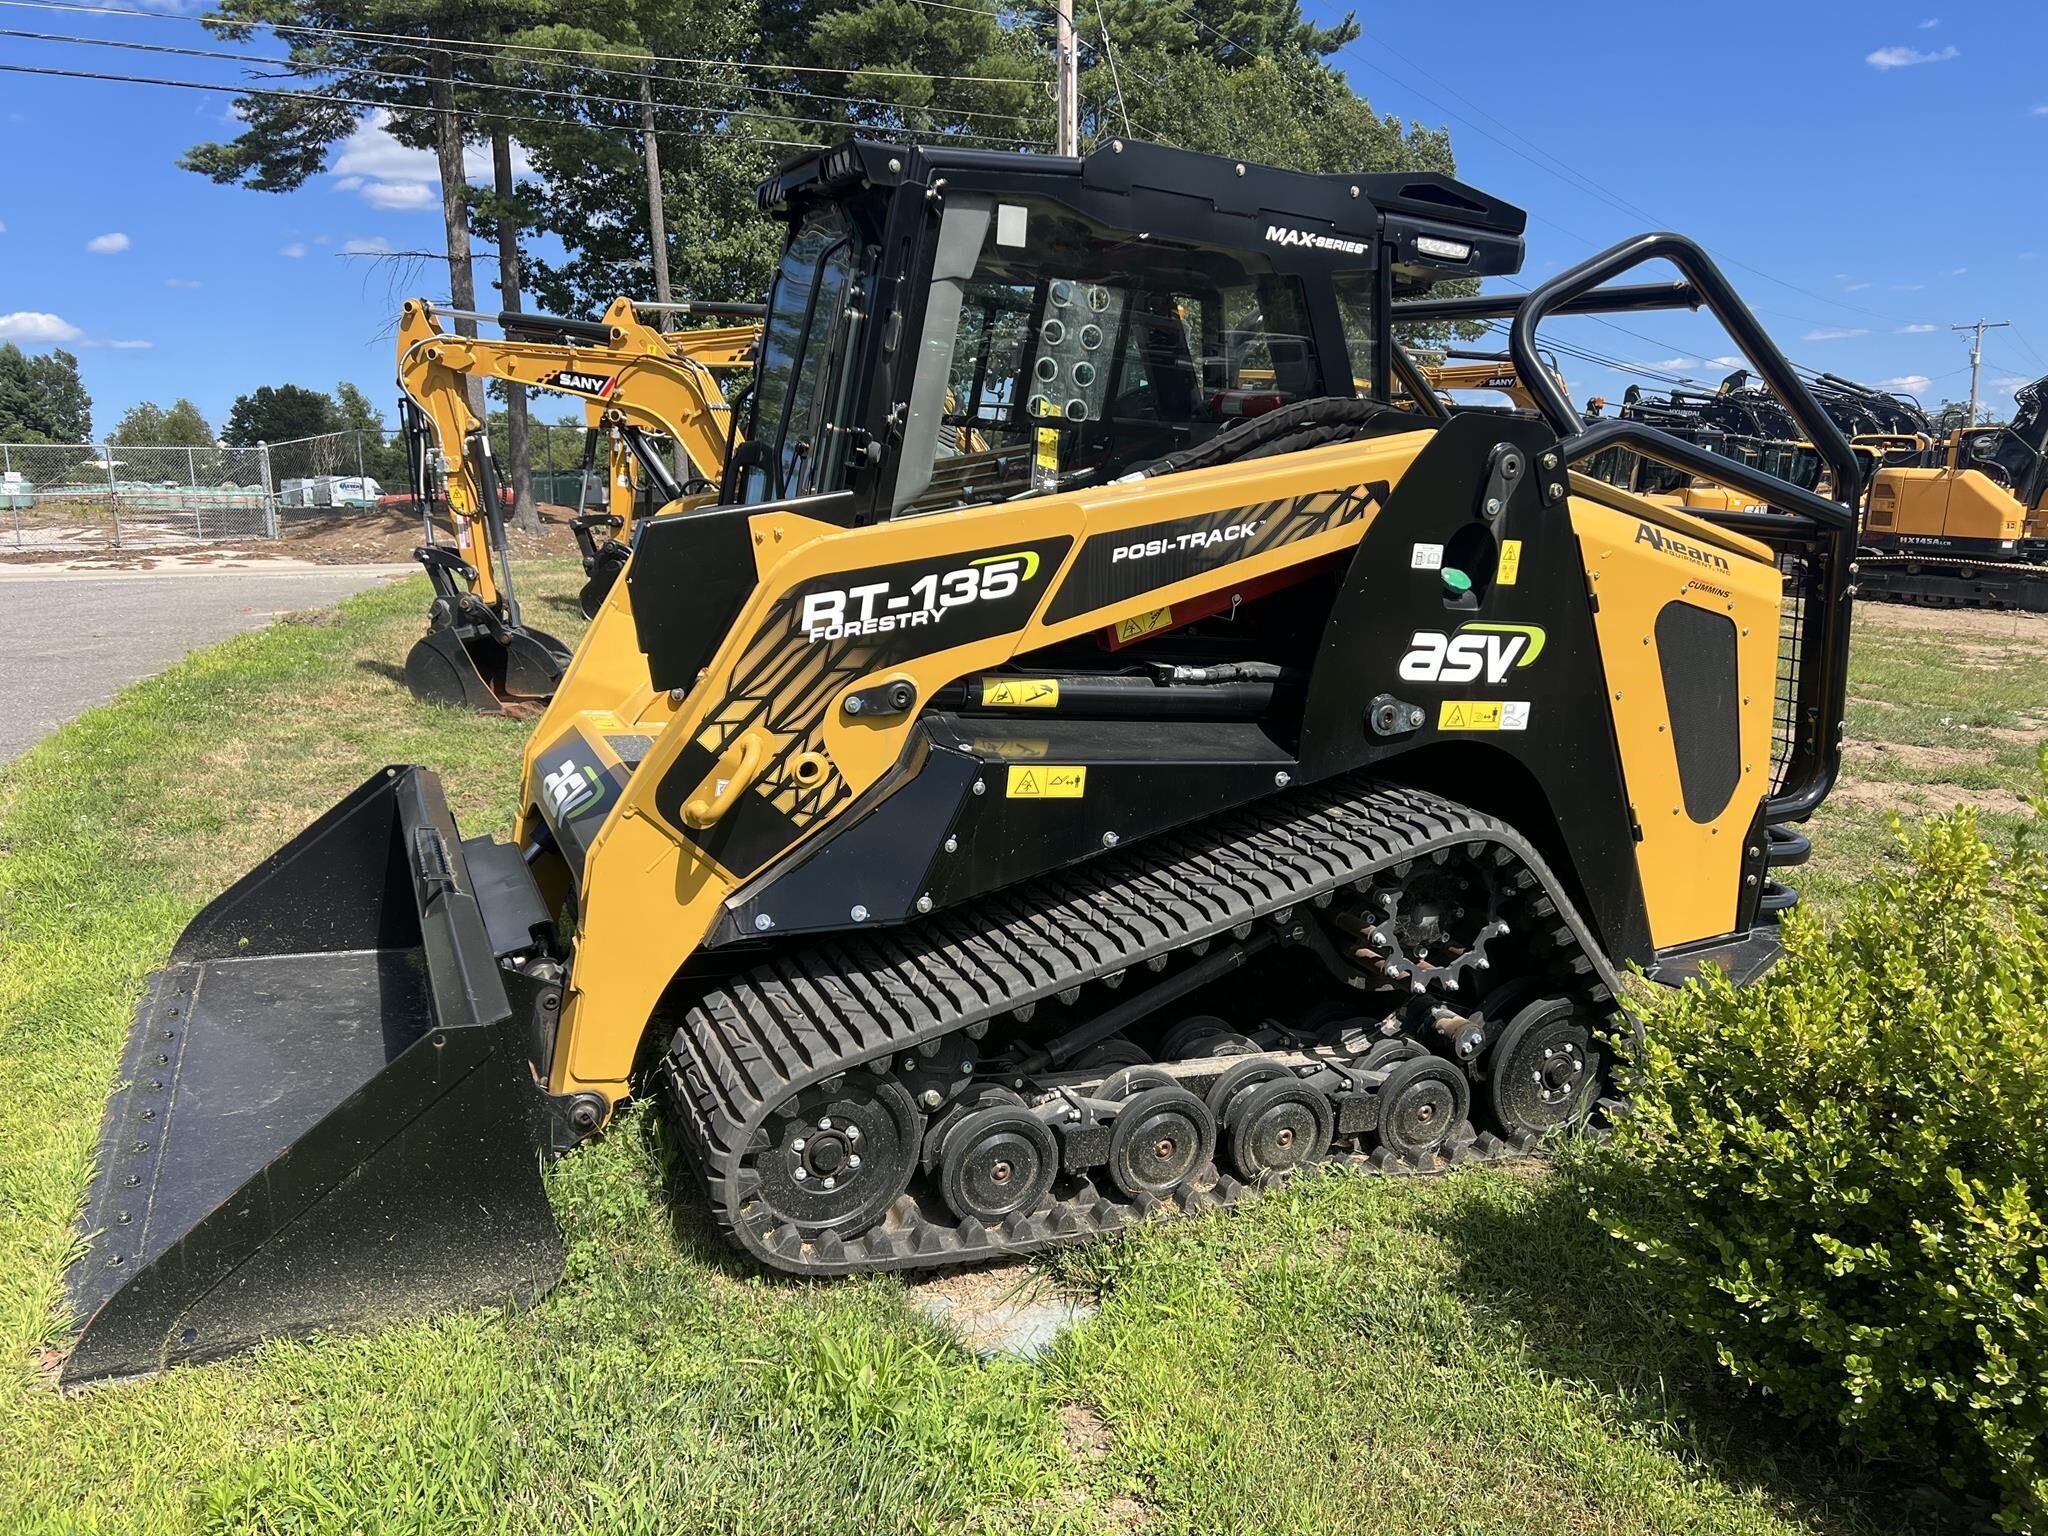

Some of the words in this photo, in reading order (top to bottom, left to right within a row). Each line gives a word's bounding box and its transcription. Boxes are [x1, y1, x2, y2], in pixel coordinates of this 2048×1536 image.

[559, 373, 604, 392] SANY
[1488, 378, 1514, 386] SANY
[1634, 523, 1730, 571] Ahearn
[801, 560, 1020, 632] RT-135
[1687, 580, 1734, 599] CUMMINS
[808, 606, 948, 644] FORESTRY
